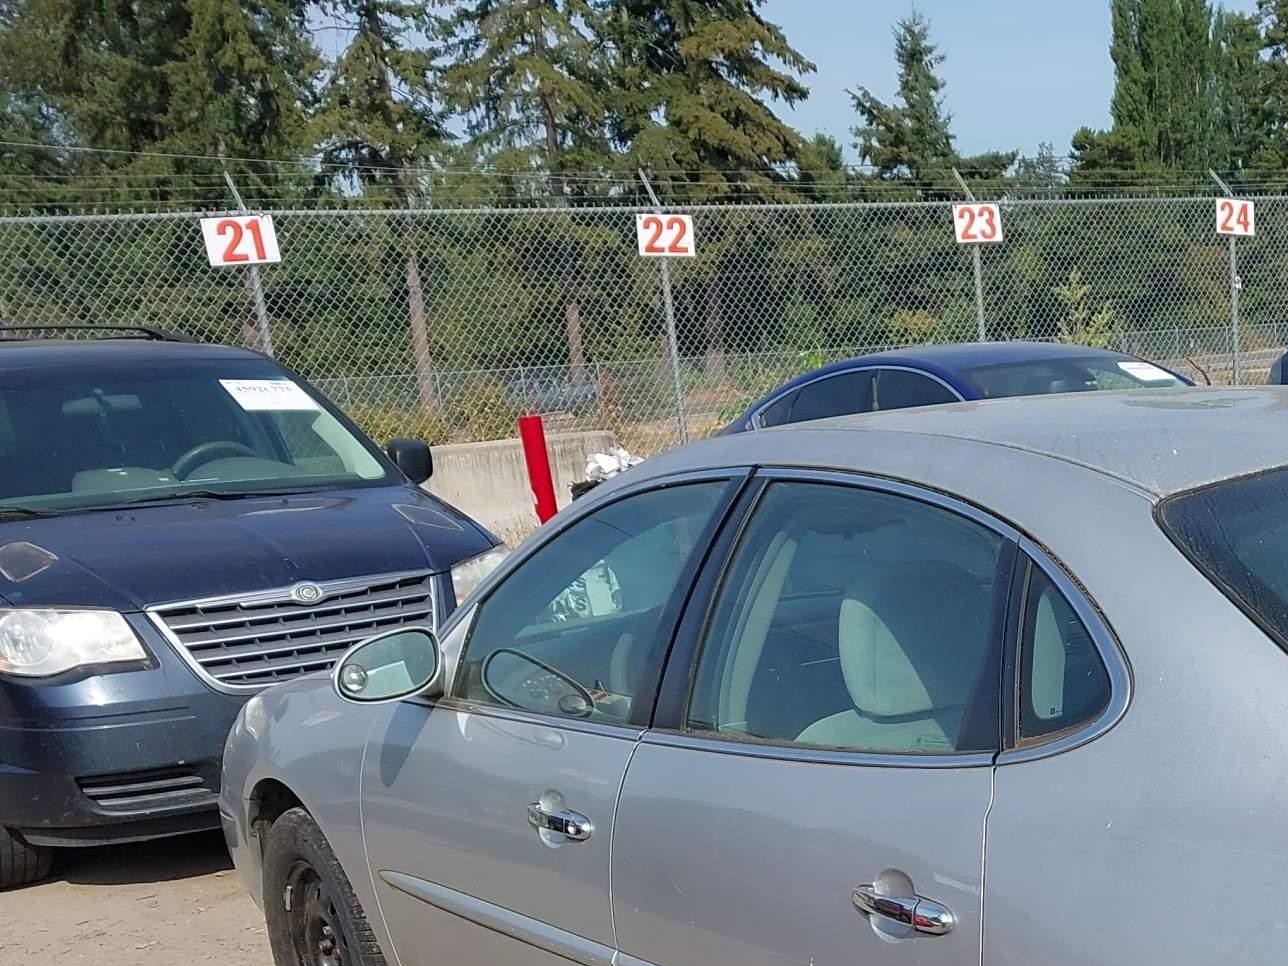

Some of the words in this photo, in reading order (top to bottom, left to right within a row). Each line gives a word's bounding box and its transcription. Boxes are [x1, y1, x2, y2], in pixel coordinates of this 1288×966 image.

[959, 206, 996, 239] 23
[1220, 201, 1250, 232] 24
[216, 219, 267, 262] 21
[643, 217, 688, 253] 22
